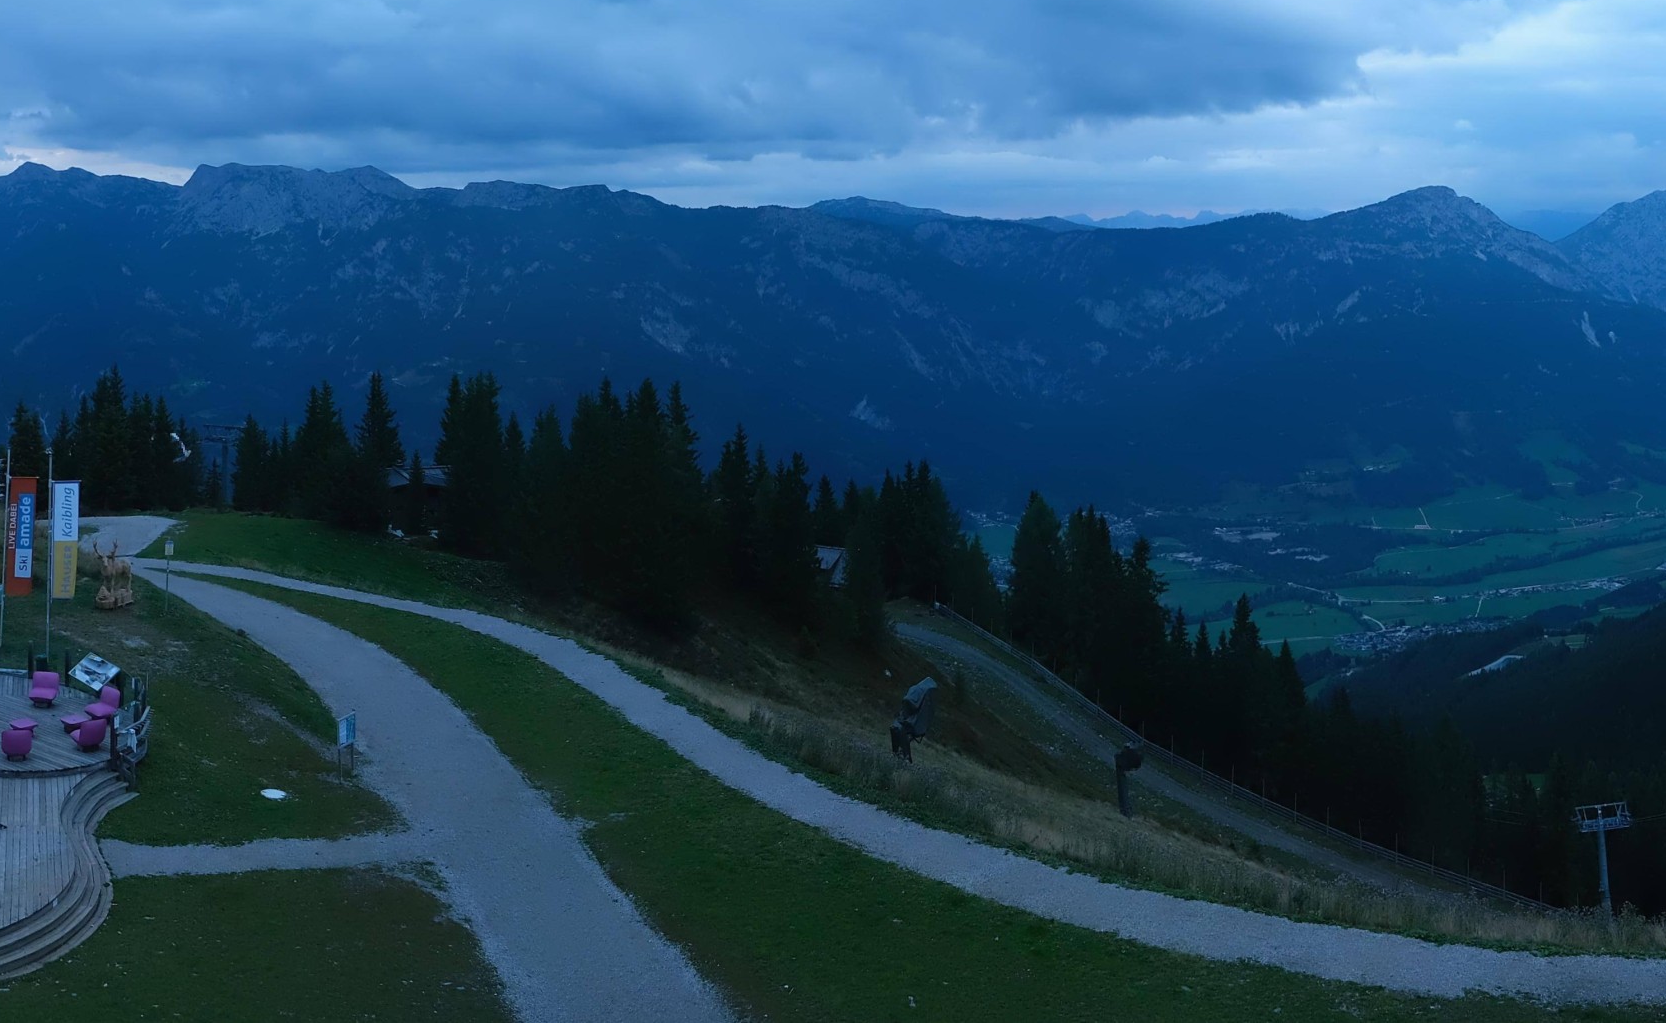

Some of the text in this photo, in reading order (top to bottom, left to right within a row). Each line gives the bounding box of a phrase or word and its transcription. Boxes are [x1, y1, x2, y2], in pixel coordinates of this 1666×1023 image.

[8, 503, 18, 550] LIVE DABEI
[19, 496, 32, 571] Ski amade
[61, 487, 75, 537] Kaibling
